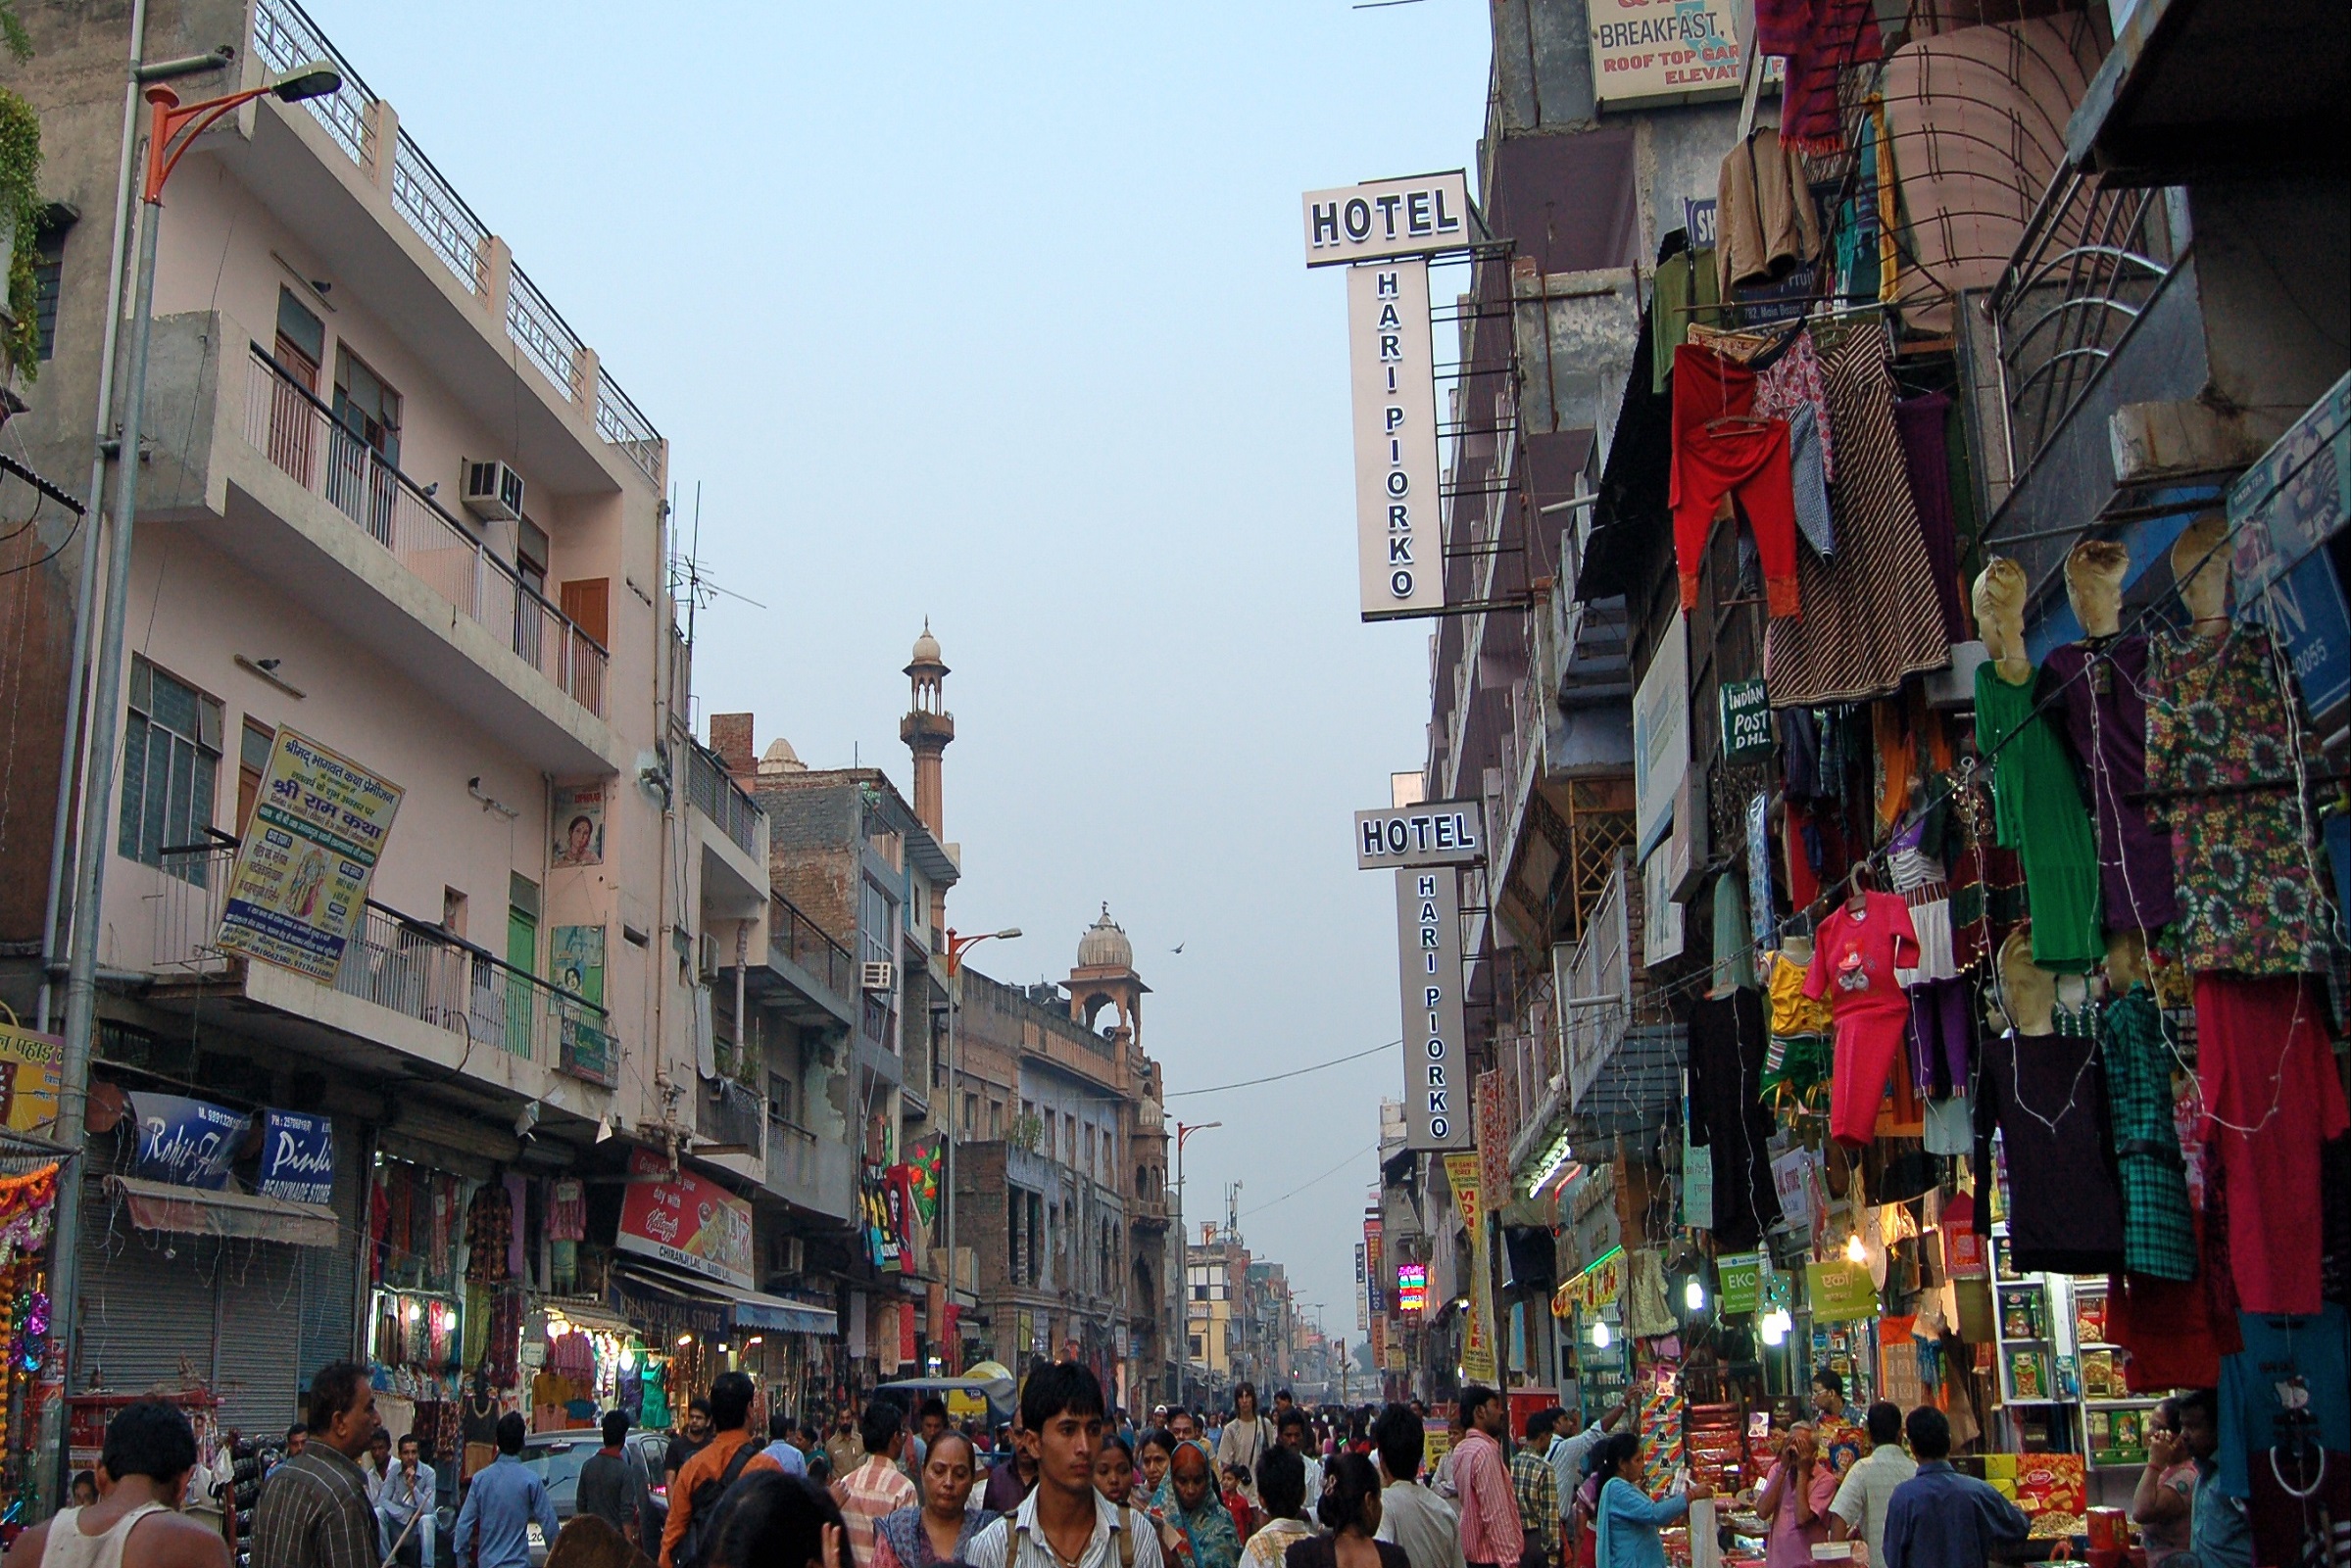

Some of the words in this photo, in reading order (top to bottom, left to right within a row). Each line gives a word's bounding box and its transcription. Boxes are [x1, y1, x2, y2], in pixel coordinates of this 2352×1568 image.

[1599, 10, 1725, 49] BREAKFAST,
[1603, 53, 1654, 74] ROOF
[1657, 49, 1697, 67] TOP
[1702, 44, 1739, 61] GAR
[1665, 64, 1740, 84] ELEVAT
[1311, 187, 1460, 247] HOTEL
[1696, 209, 1717, 242] SH
[1377, 270, 1401, 394] HARI
[1384, 407, 1415, 598] PIORKO
[2295, 637, 2328, 678] 0055
[1728, 683, 1765, 710] INDIAN
[1734, 709, 1769, 735] POST
[1736, 733, 1771, 750] DHL.
[312, 753, 344, 778] भागवत
[344, 770, 364, 788] कथा
[273, 779, 300, 801] श्री
[304, 791, 340, 819] राम
[342, 810, 383, 840] कथा
[1361, 811, 1475, 857] HOTEL
[1417, 874, 1439, 974] HARI
[1424, 985, 1449, 1139] PIORKO
[142, 1116, 195, 1169] Rohit
[271, 1131, 332, 1177] Pinki
[263, 1178, 311, 1202] READYMADE
[308, 1183, 332, 1204] STORE
[654, 1186, 667, 1205] day
[667, 1193, 681, 1208] with
[1728, 1272, 1755, 1289] EKO
[692, 1308, 721, 1333] STORE
